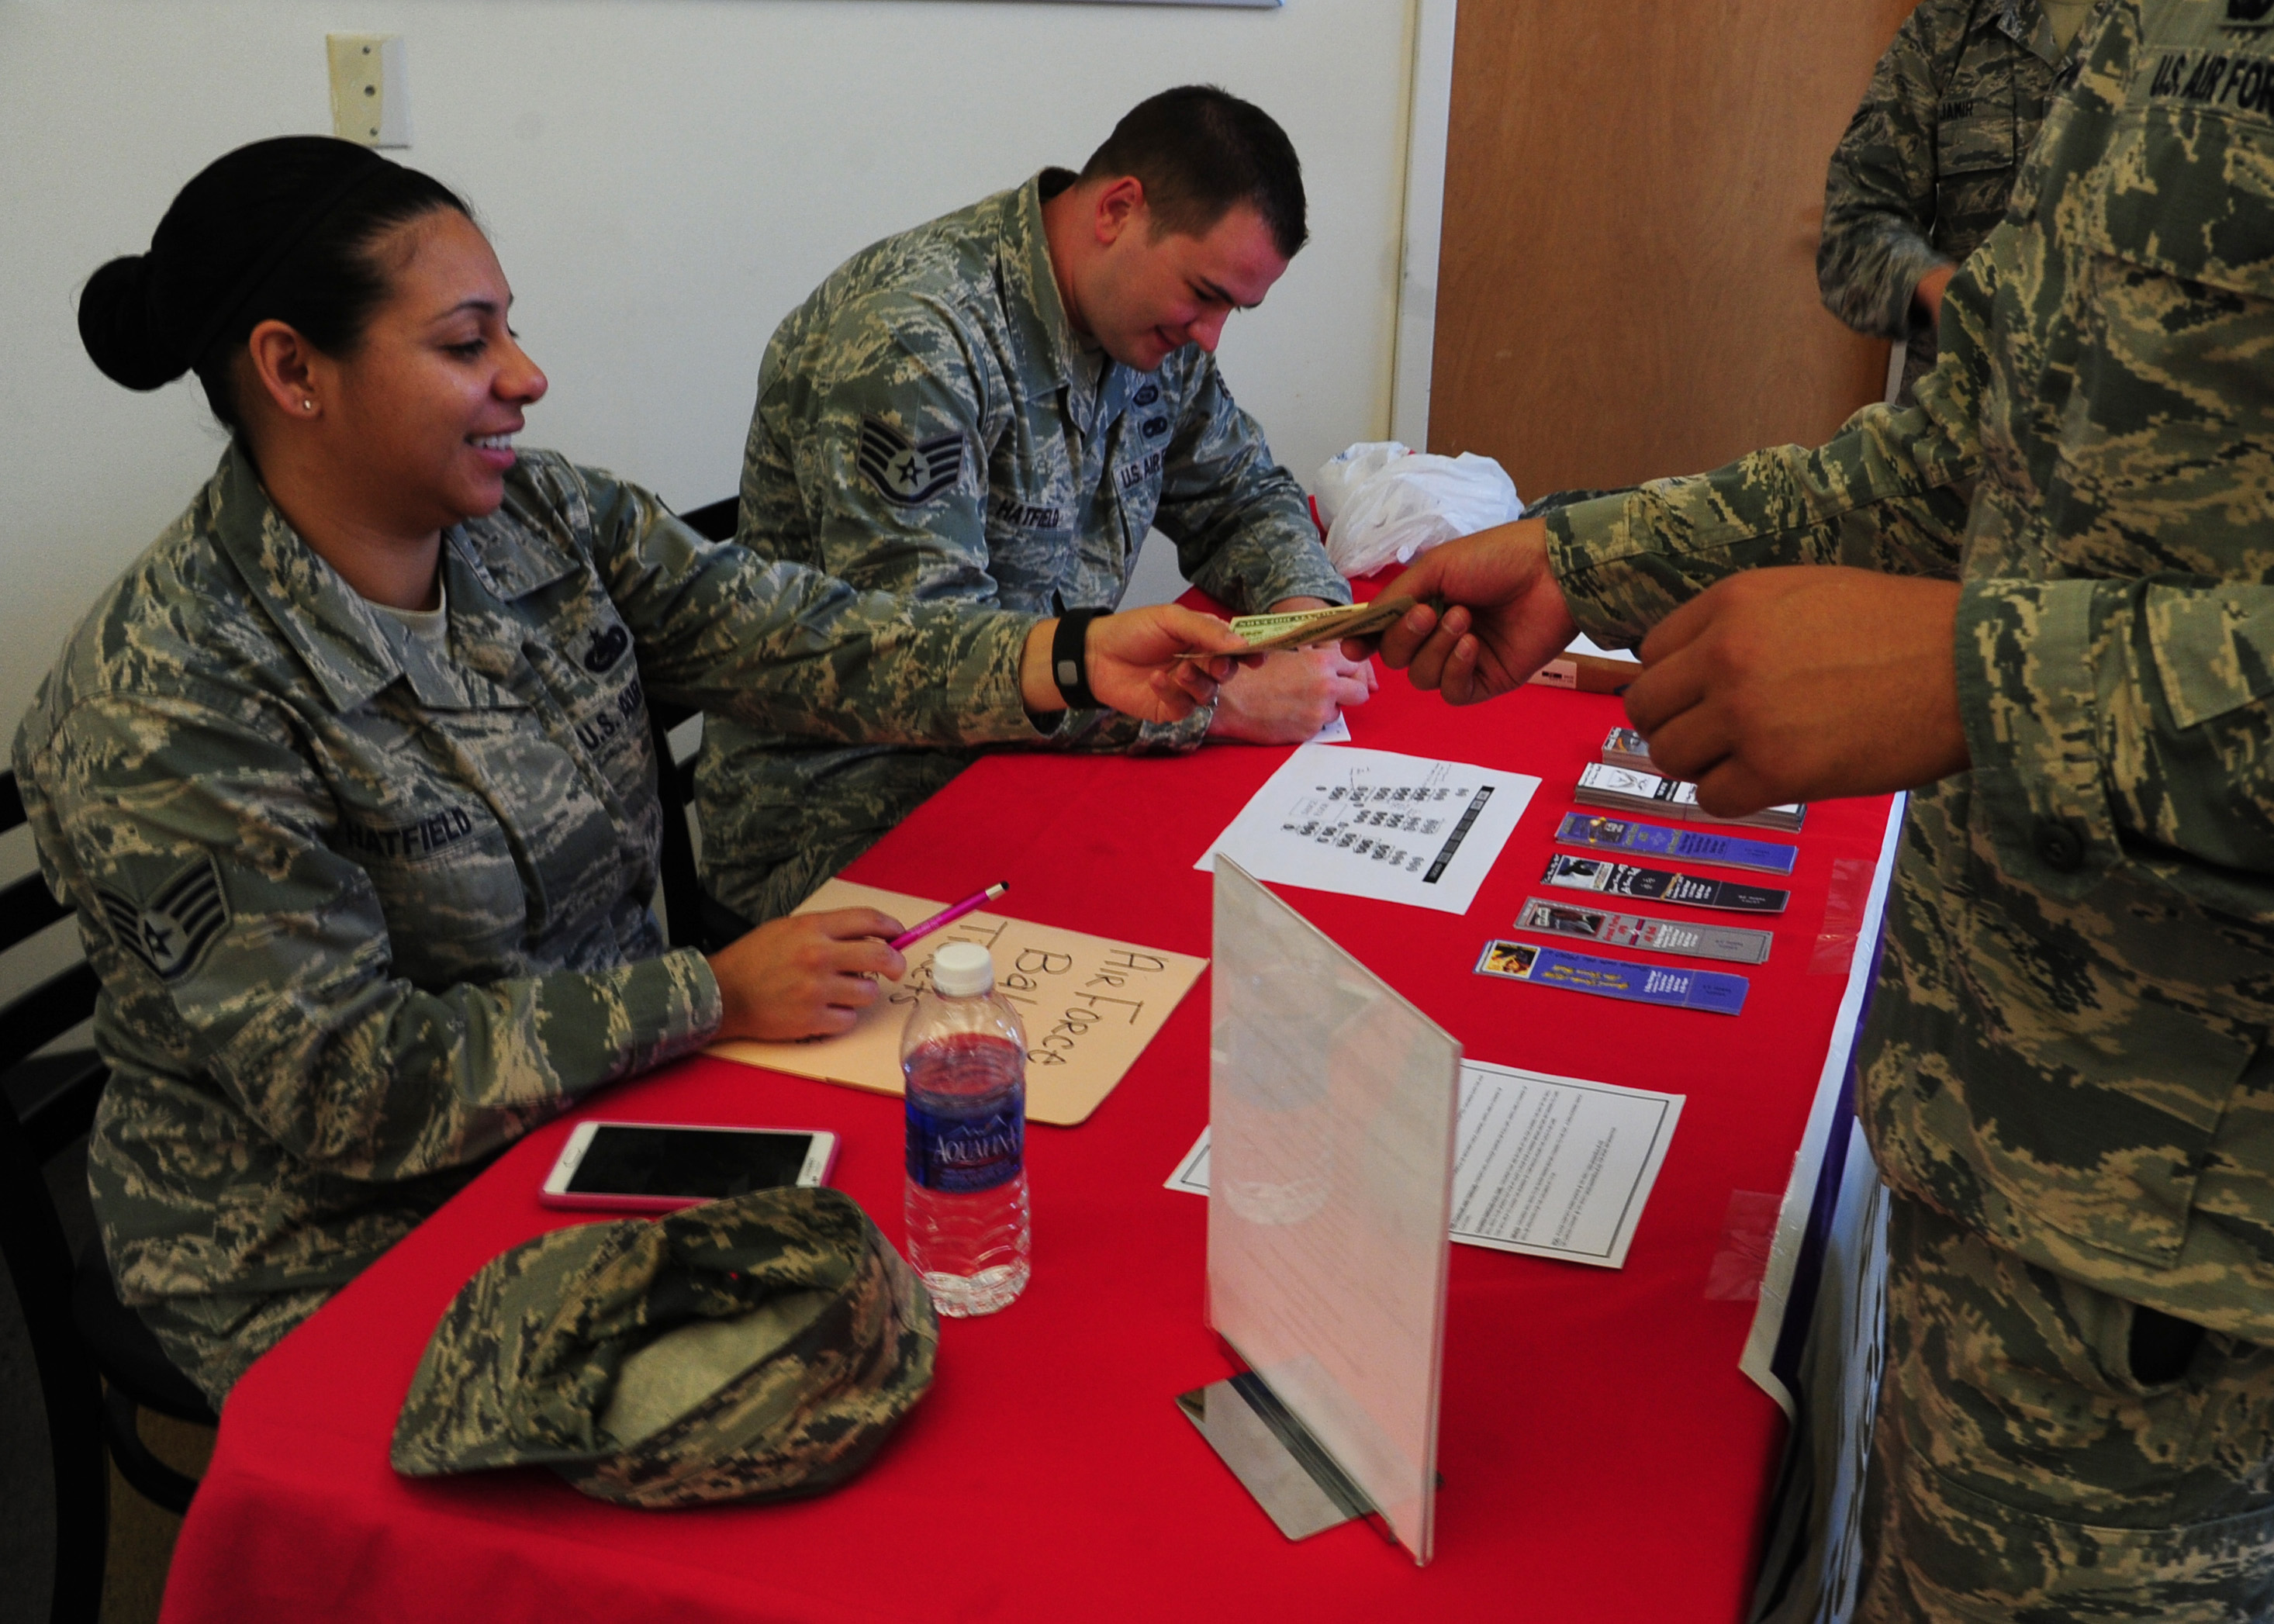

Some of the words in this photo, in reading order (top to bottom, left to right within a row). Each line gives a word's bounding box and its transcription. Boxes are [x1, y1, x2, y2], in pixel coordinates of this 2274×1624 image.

[2180, 54, 2228, 102] AIR
[1121, 465, 1143, 489] U.S.
[1144, 453, 1161, 479] AIR
[995, 498, 1059, 528] HATFIELD
[575, 712, 620, 750] U.S.
[618, 679, 643, 721] AIR
[346, 805, 472, 858] HATFIELD
[1085, 948, 1169, 988] AIR
